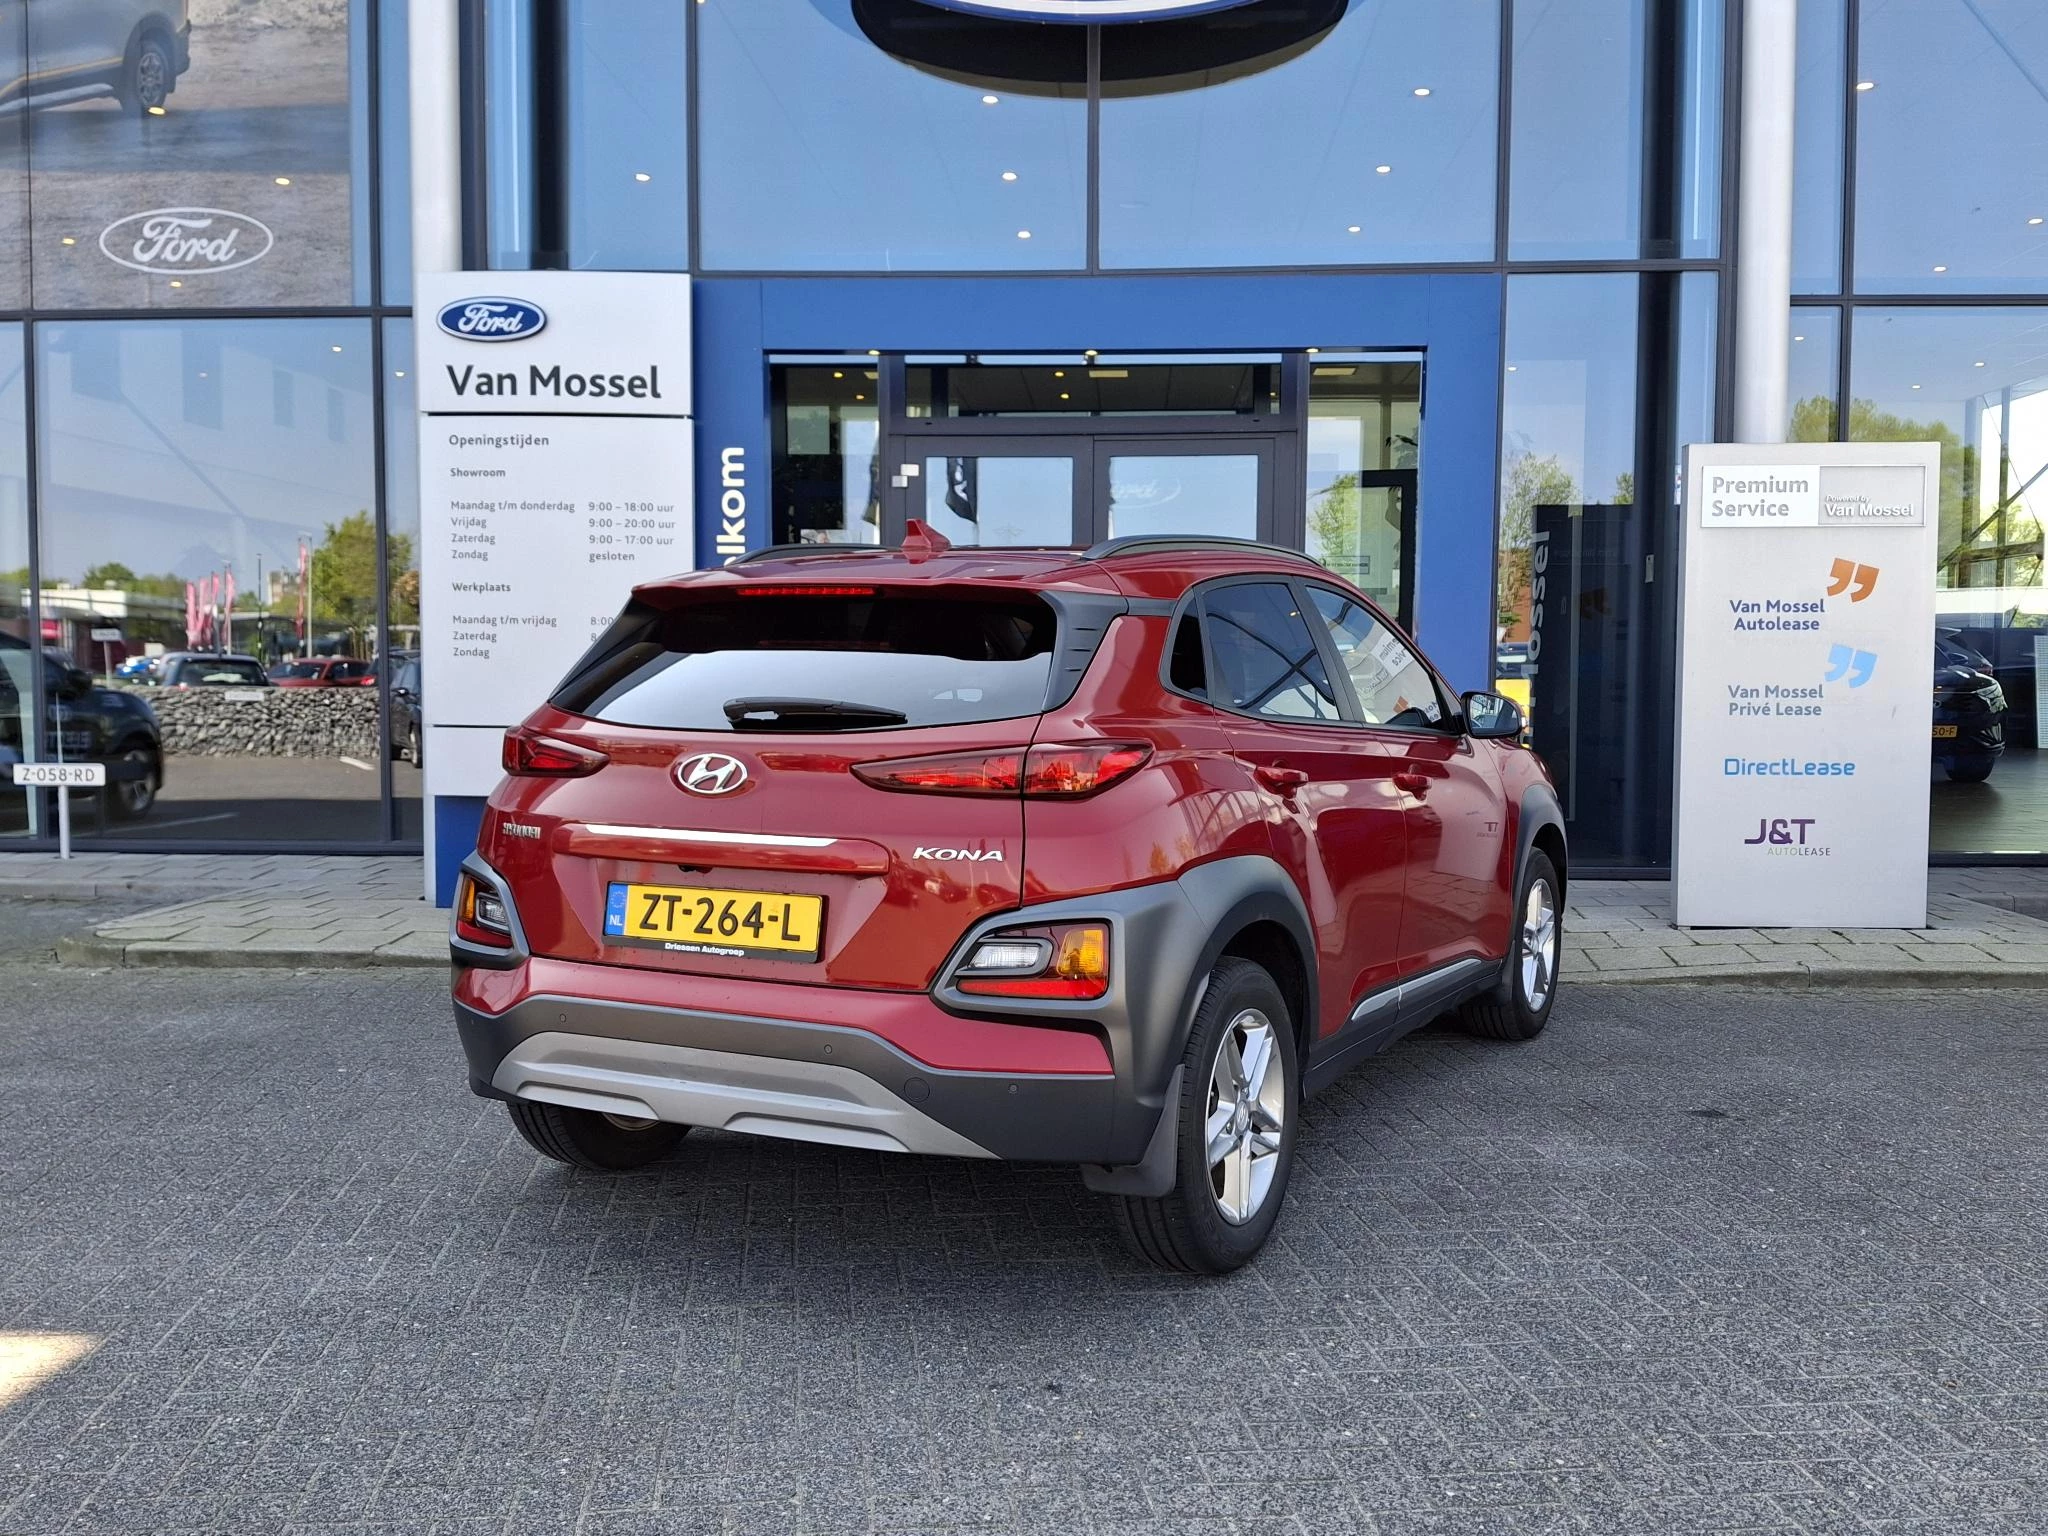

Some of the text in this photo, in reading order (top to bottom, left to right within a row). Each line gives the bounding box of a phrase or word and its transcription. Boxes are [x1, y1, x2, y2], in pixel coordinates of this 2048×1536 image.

[133, 214, 239, 264] Ford
[458, 303, 522, 333] Ford
[446, 364, 662, 398] Van Mossel
[449, 433, 550, 449] Openingstijden
[450, 467, 506, 479] Showroom
[1711, 475, 1809, 494] Premium
[450, 500, 496, 512] Maandag
[498, 500, 517, 511] t/m
[519, 500, 576, 514] donderdag
[588, 502, 613, 512] 9:00
[624, 502, 654, 512] 18:00
[657, 504, 675, 513] uur
[1711, 498, 1790, 517] Service
[1825, 503, 1915, 517] Van Mossel
[450, 516, 487, 529] Vrijdag
[588, 518, 613, 528] 9:00
[624, 518, 655, 529] 20:00
[658, 521, 676, 529] uur
[451, 532, 496, 545] Zaterdag
[589, 534, 613, 544] 9:00
[625, 535, 653, 545] 17:00
[451, 548, 635, 563] Zondag gesloten
[452, 581, 511, 594] Werkplaats
[1729, 599, 1825, 614] Van Mossel
[452, 614, 497, 627] Maandag
[499, 614, 519, 625] t/m
[521, 614, 557, 627] vrijdag
[1733, 616, 1821, 631] Autolease
[452, 630, 497, 643] Zaterdag
[452, 646, 490, 659] Zondag
[1728, 684, 1823, 699] Van Mossel
[1728, 702, 1822, 716] Privé Lease
[1724, 757, 1856, 777] DirectLease
[23, 768, 95, 782] Z-058-RD
[1744, 819, 1816, 845] J&T
[912, 847, 1003, 862] KONA
[1767, 847, 1831, 857] AUTOLEASE
[609, 914, 623, 927] NL
[639, 893, 801, 942] ZT-264-L
[702, 945, 745, 957] Autogroep
